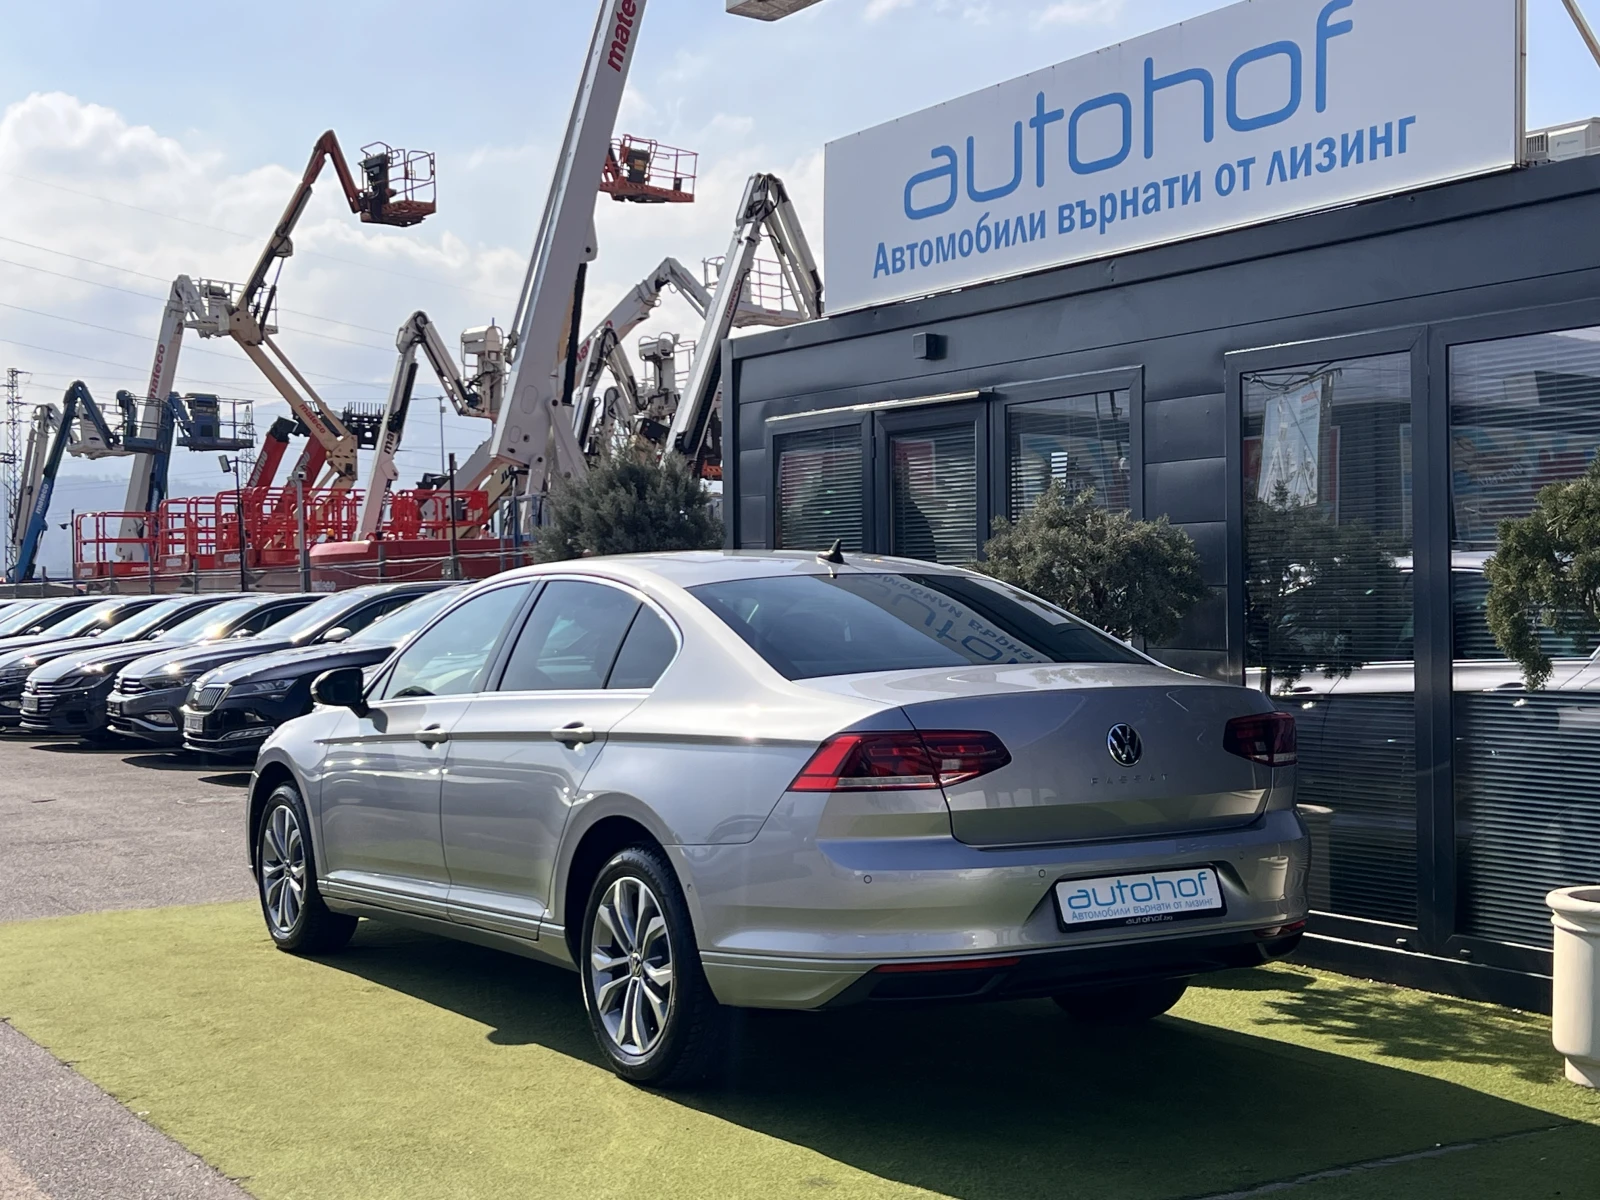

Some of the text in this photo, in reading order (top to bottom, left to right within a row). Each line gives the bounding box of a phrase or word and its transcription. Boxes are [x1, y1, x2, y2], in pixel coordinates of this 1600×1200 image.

[904, 0, 1353, 221] autohof
[872, 115, 1416, 279] Автомобили върнати от лизинг
[298, 403, 327, 434] mateco
[35, 483, 49, 515] mateco
[1067, 871, 1208, 910] autohof
[1071, 897, 1214, 922] Автомобили върнати от лизинг
